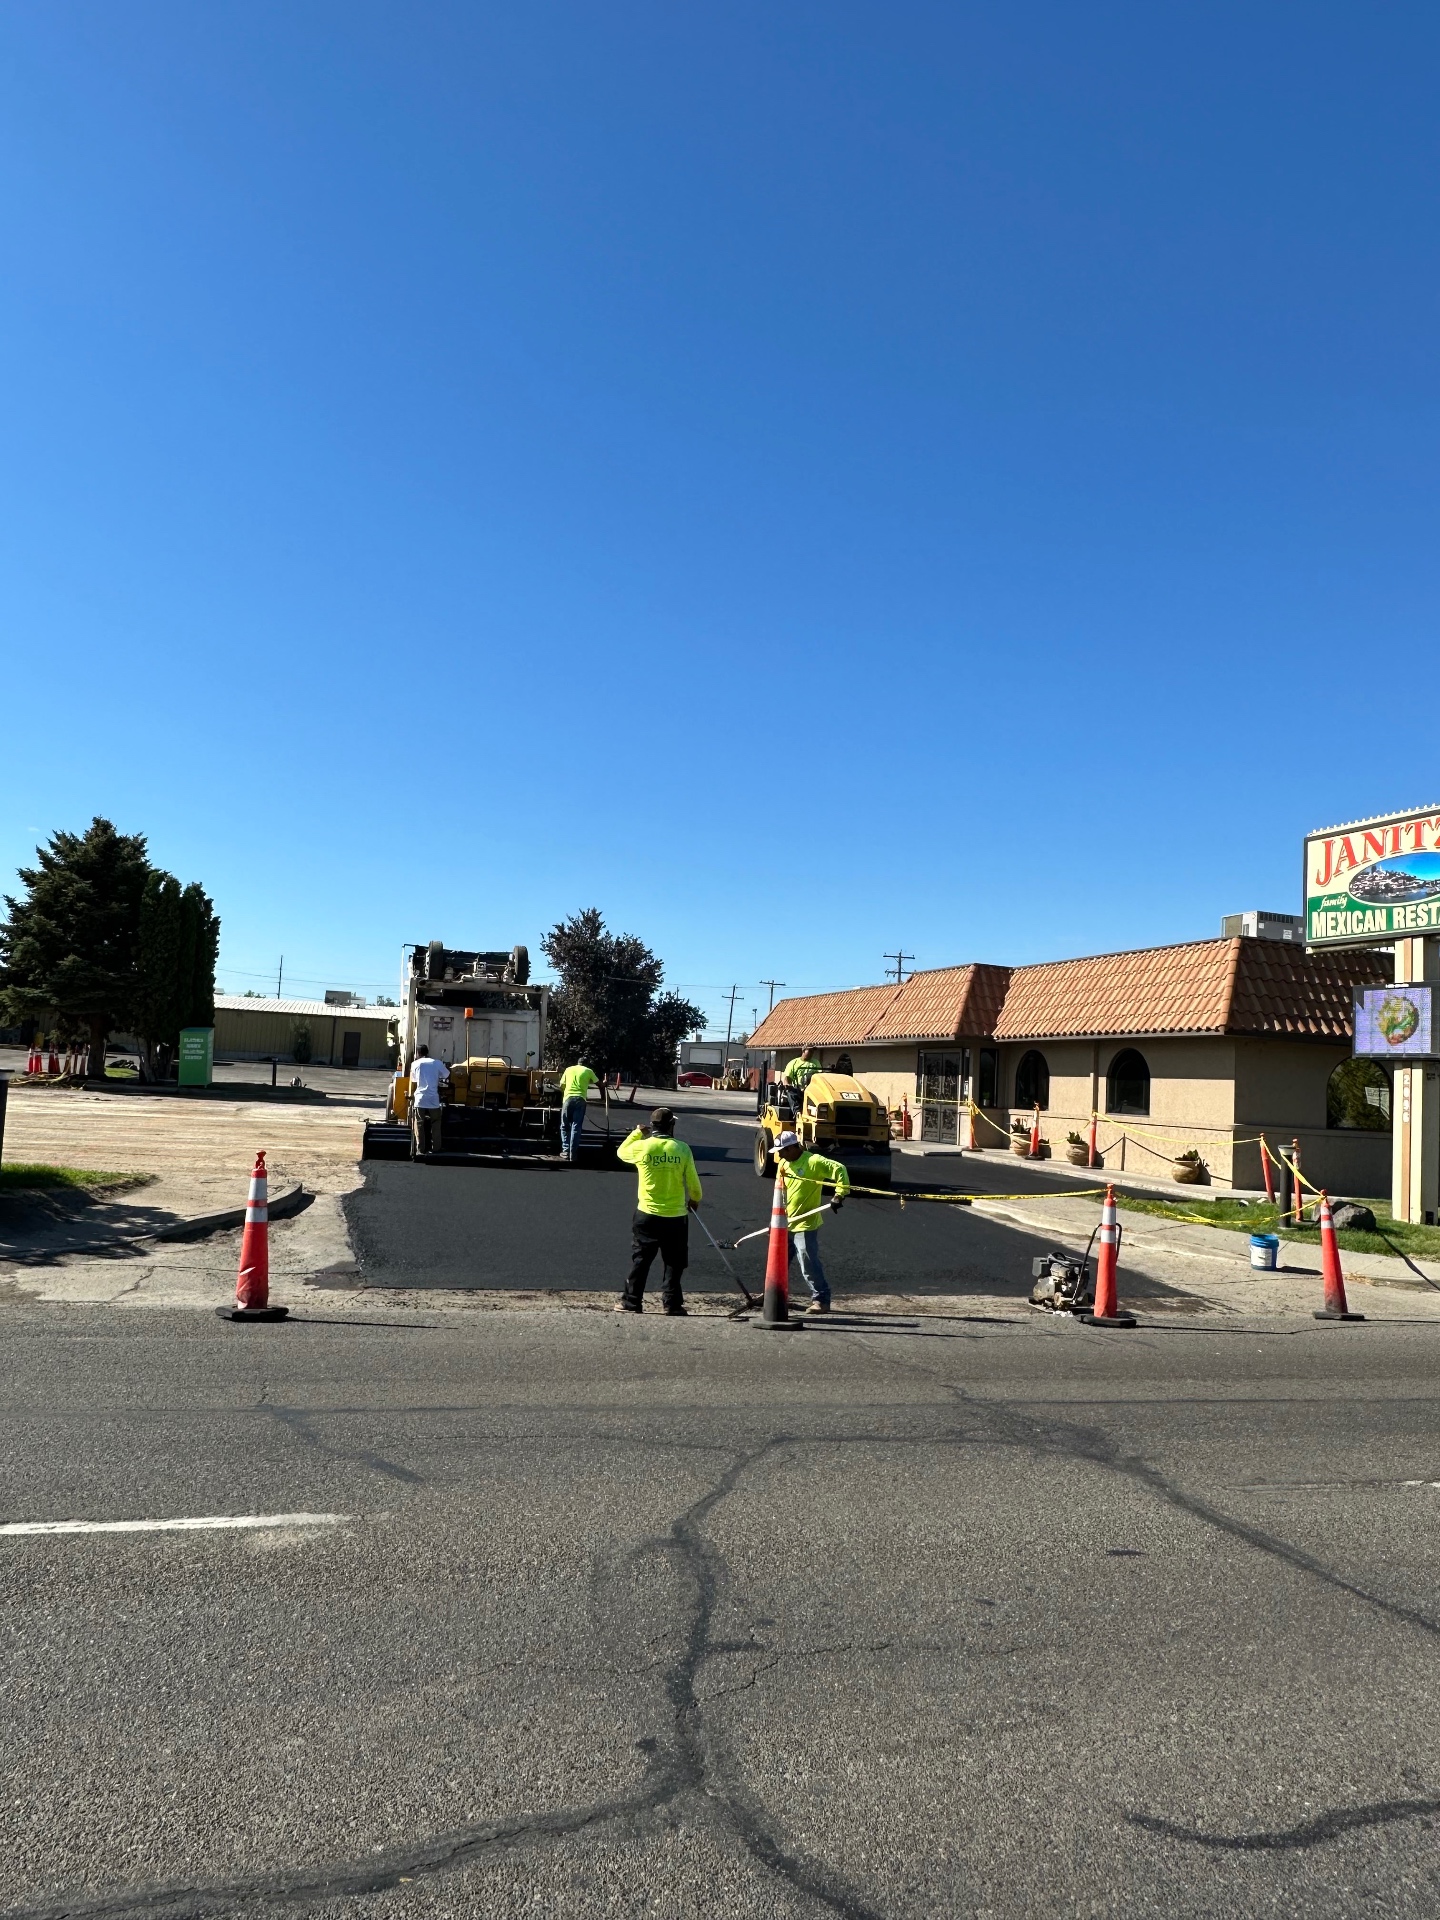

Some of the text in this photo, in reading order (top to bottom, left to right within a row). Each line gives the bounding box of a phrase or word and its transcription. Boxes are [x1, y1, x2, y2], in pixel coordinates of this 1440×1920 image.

[1317, 894, 1347, 912] family
[1312, 901, 1440, 938] MEXICAN REST
[841, 1092, 860, 1100] CAT
[642, 1152, 681, 1166] Ogden
